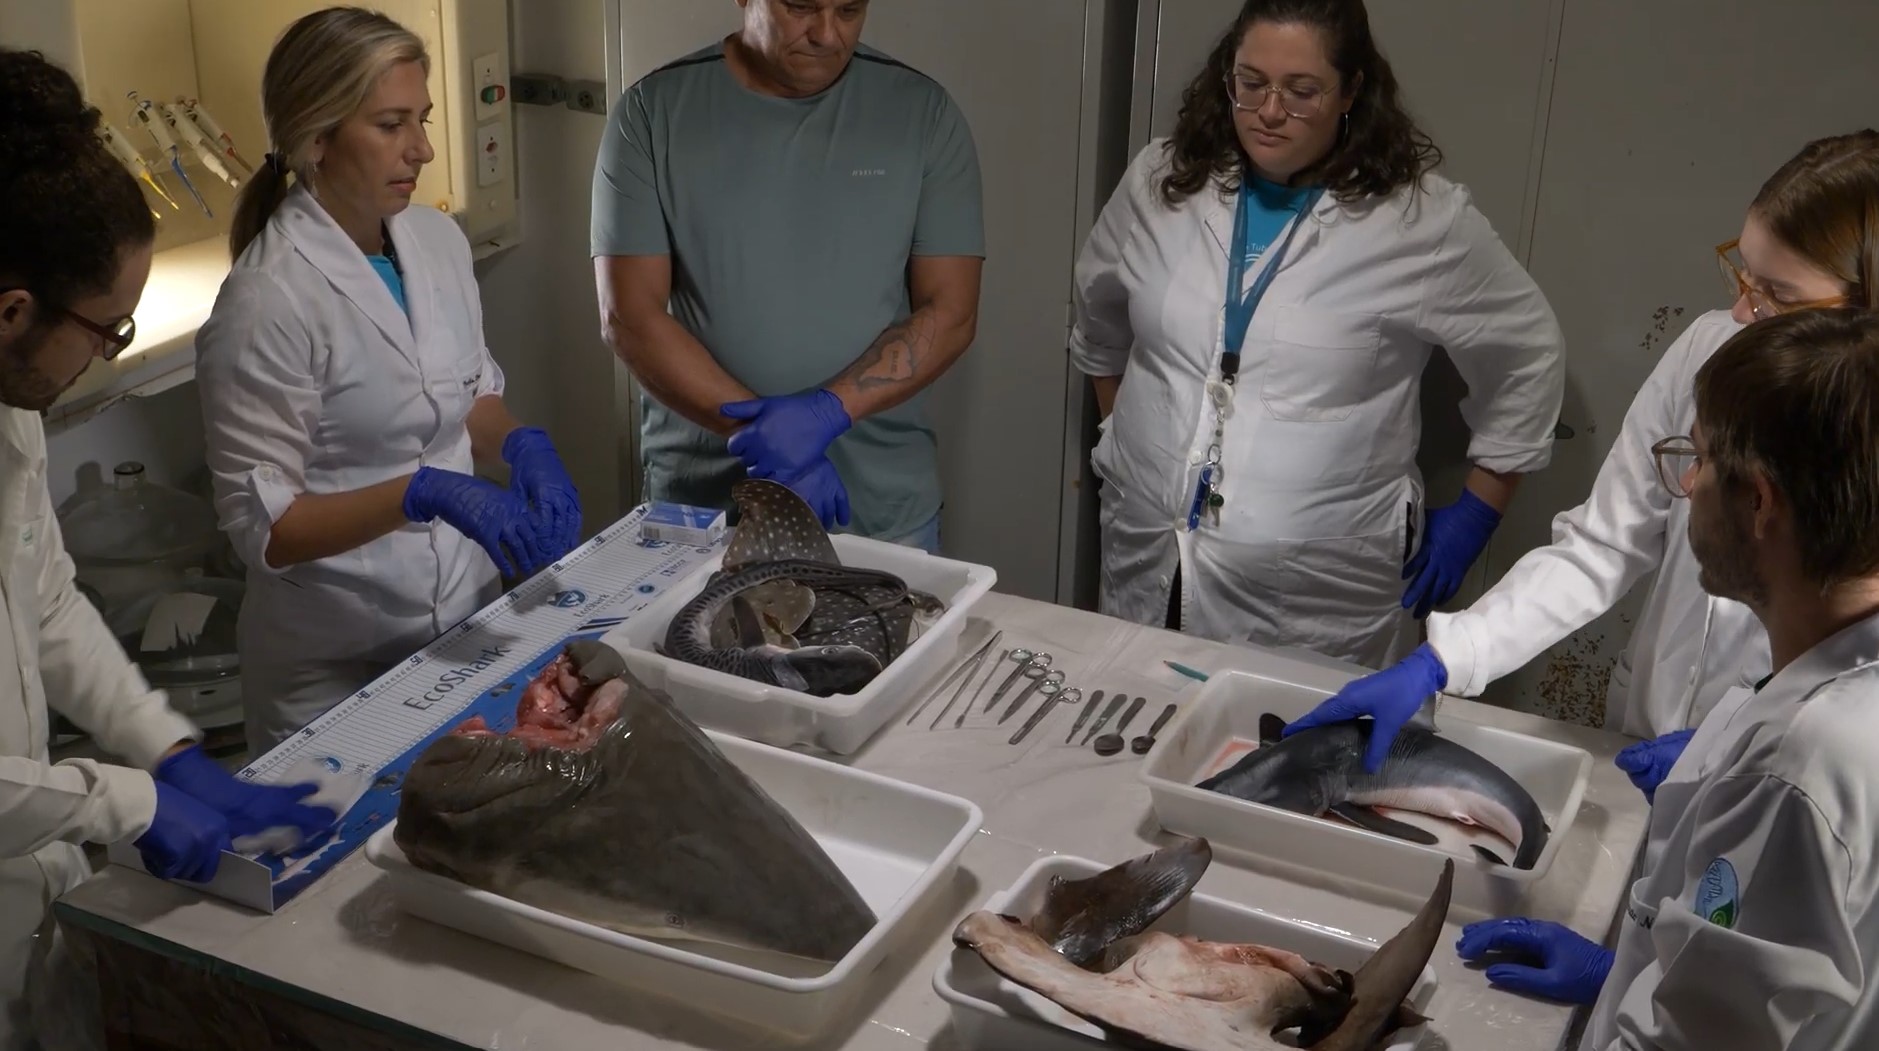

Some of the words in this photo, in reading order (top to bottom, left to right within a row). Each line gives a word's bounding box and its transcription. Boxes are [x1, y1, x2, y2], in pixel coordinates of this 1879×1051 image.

[410, 655, 423, 666] 50
[403, 645, 512, 711] EcoShark
[356, 690, 371, 699] 40
[301, 727, 316, 738] 30
[242, 767, 257, 778] 20
